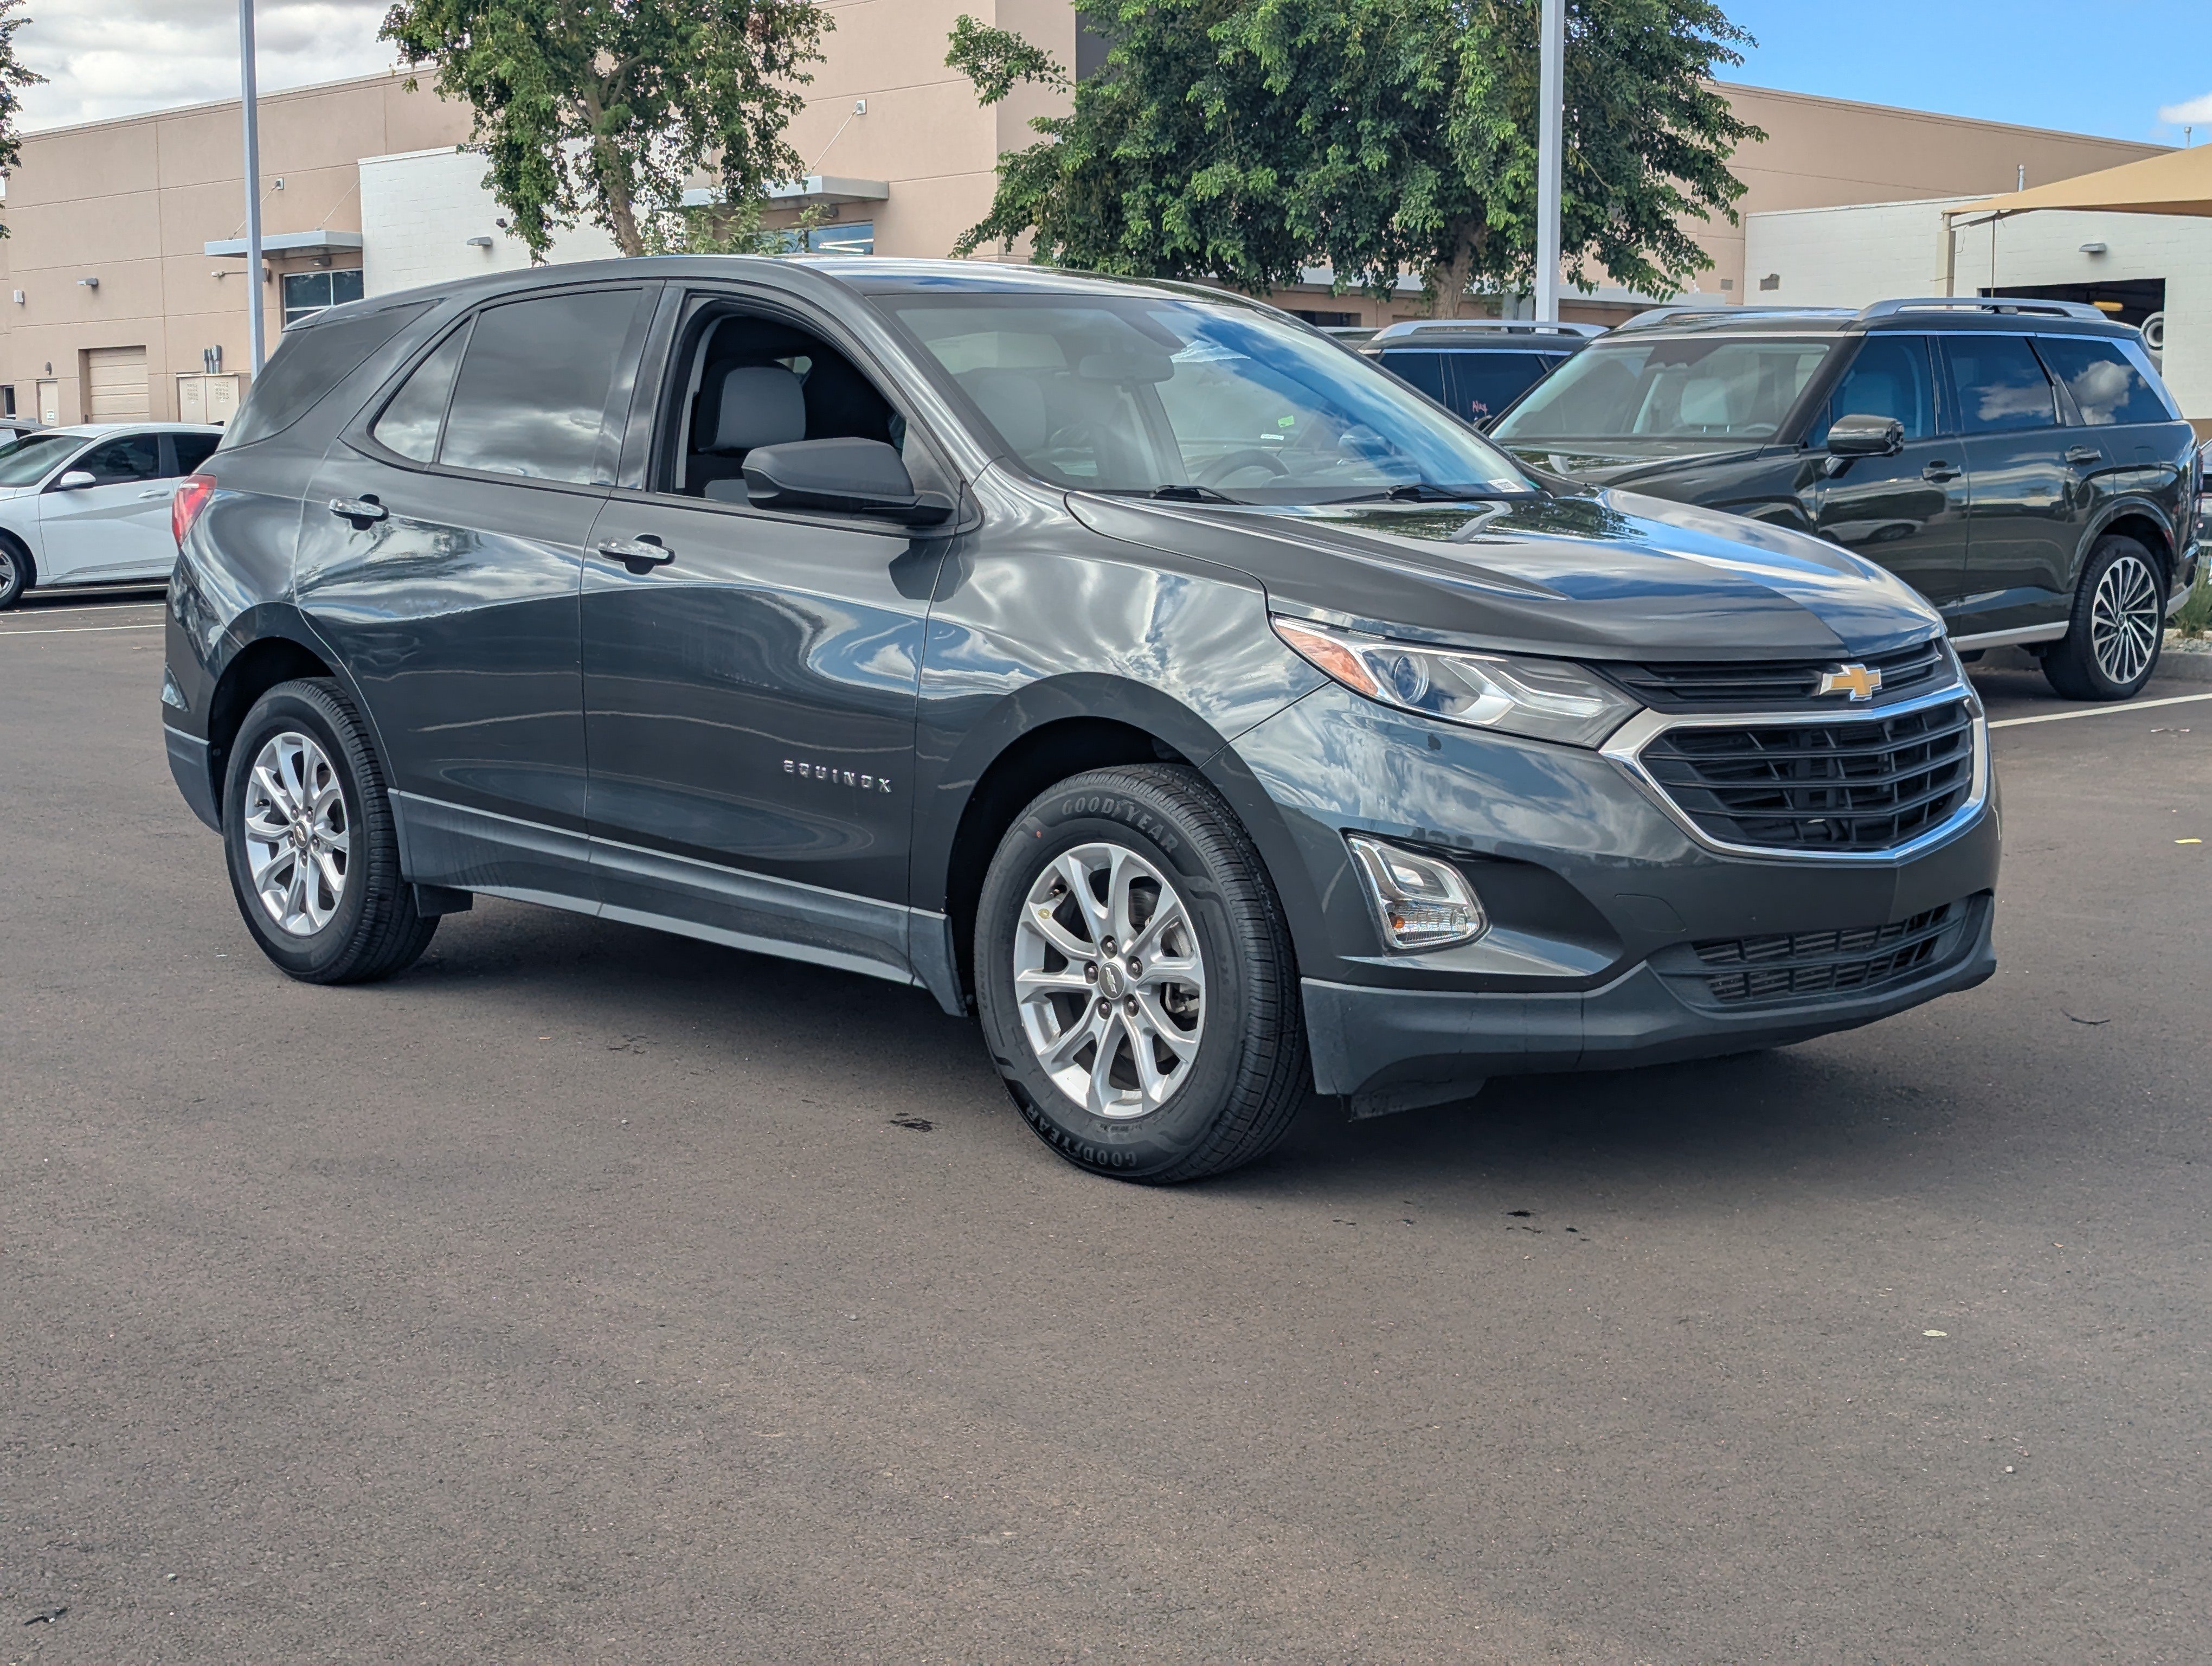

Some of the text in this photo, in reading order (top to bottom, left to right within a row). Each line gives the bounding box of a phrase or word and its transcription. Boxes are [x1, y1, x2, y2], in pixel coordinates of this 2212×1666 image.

[783, 760, 892, 793] EQUINOX
[1062, 796, 1179, 854] GOODYEAR
[1026, 1104, 1137, 1167] GOODYEAR
